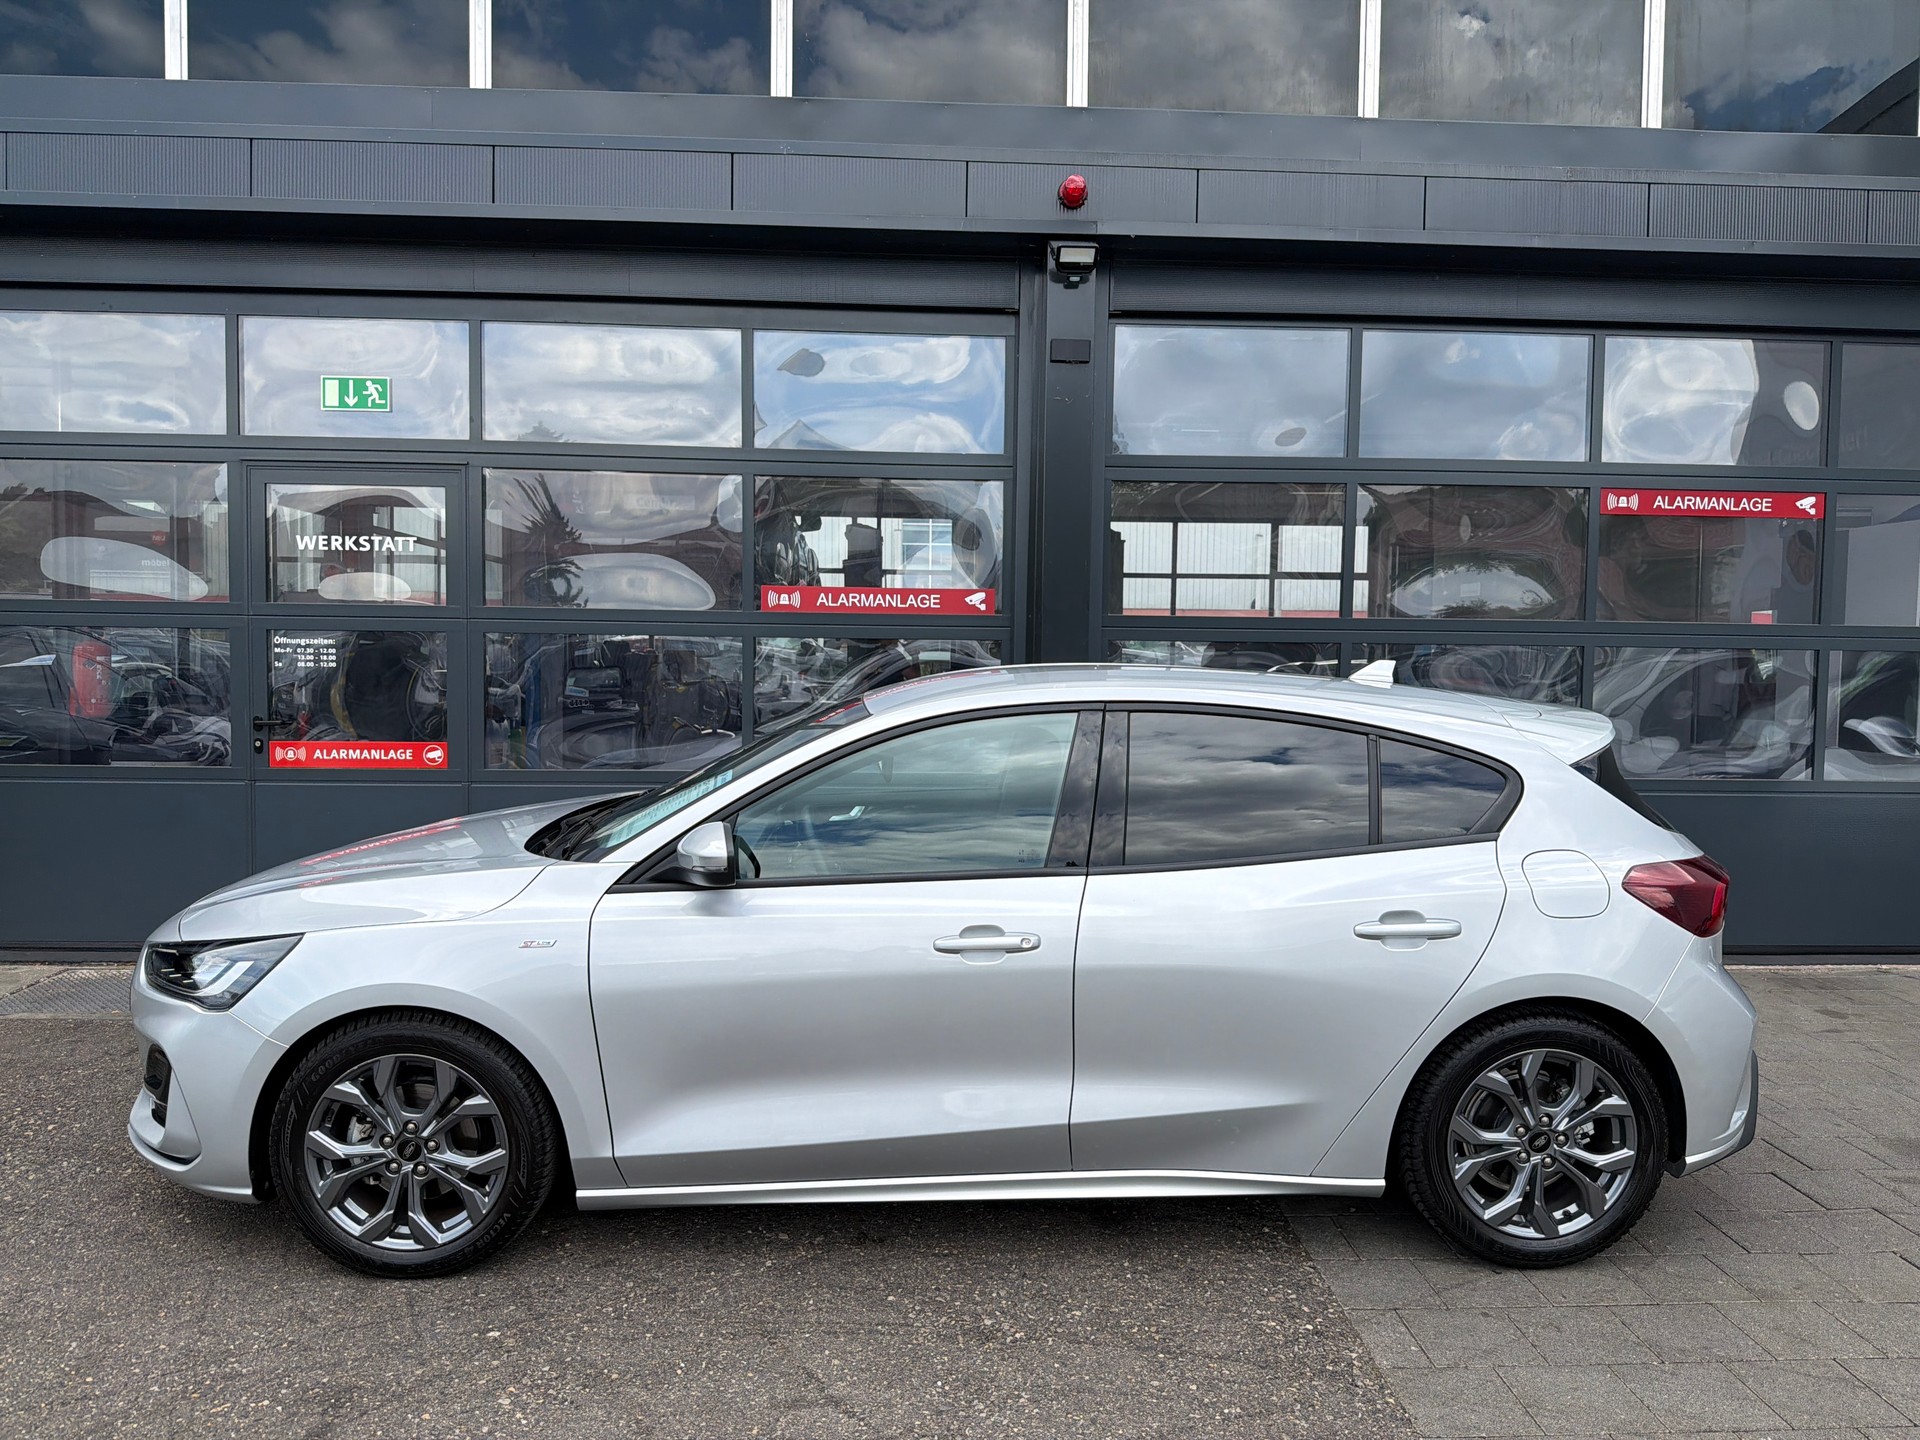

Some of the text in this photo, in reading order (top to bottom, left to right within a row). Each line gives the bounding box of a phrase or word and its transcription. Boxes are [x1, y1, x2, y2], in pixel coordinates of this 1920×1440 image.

[1653, 496, 1772, 511] ALARMANLAGE
[295, 535, 418, 552] WERKSTATT
[816, 592, 941, 608] ALARMANLAGE
[274, 636, 336, 646] Öffnungszeiten:
[313, 749, 413, 760] ALARMANLAGE
